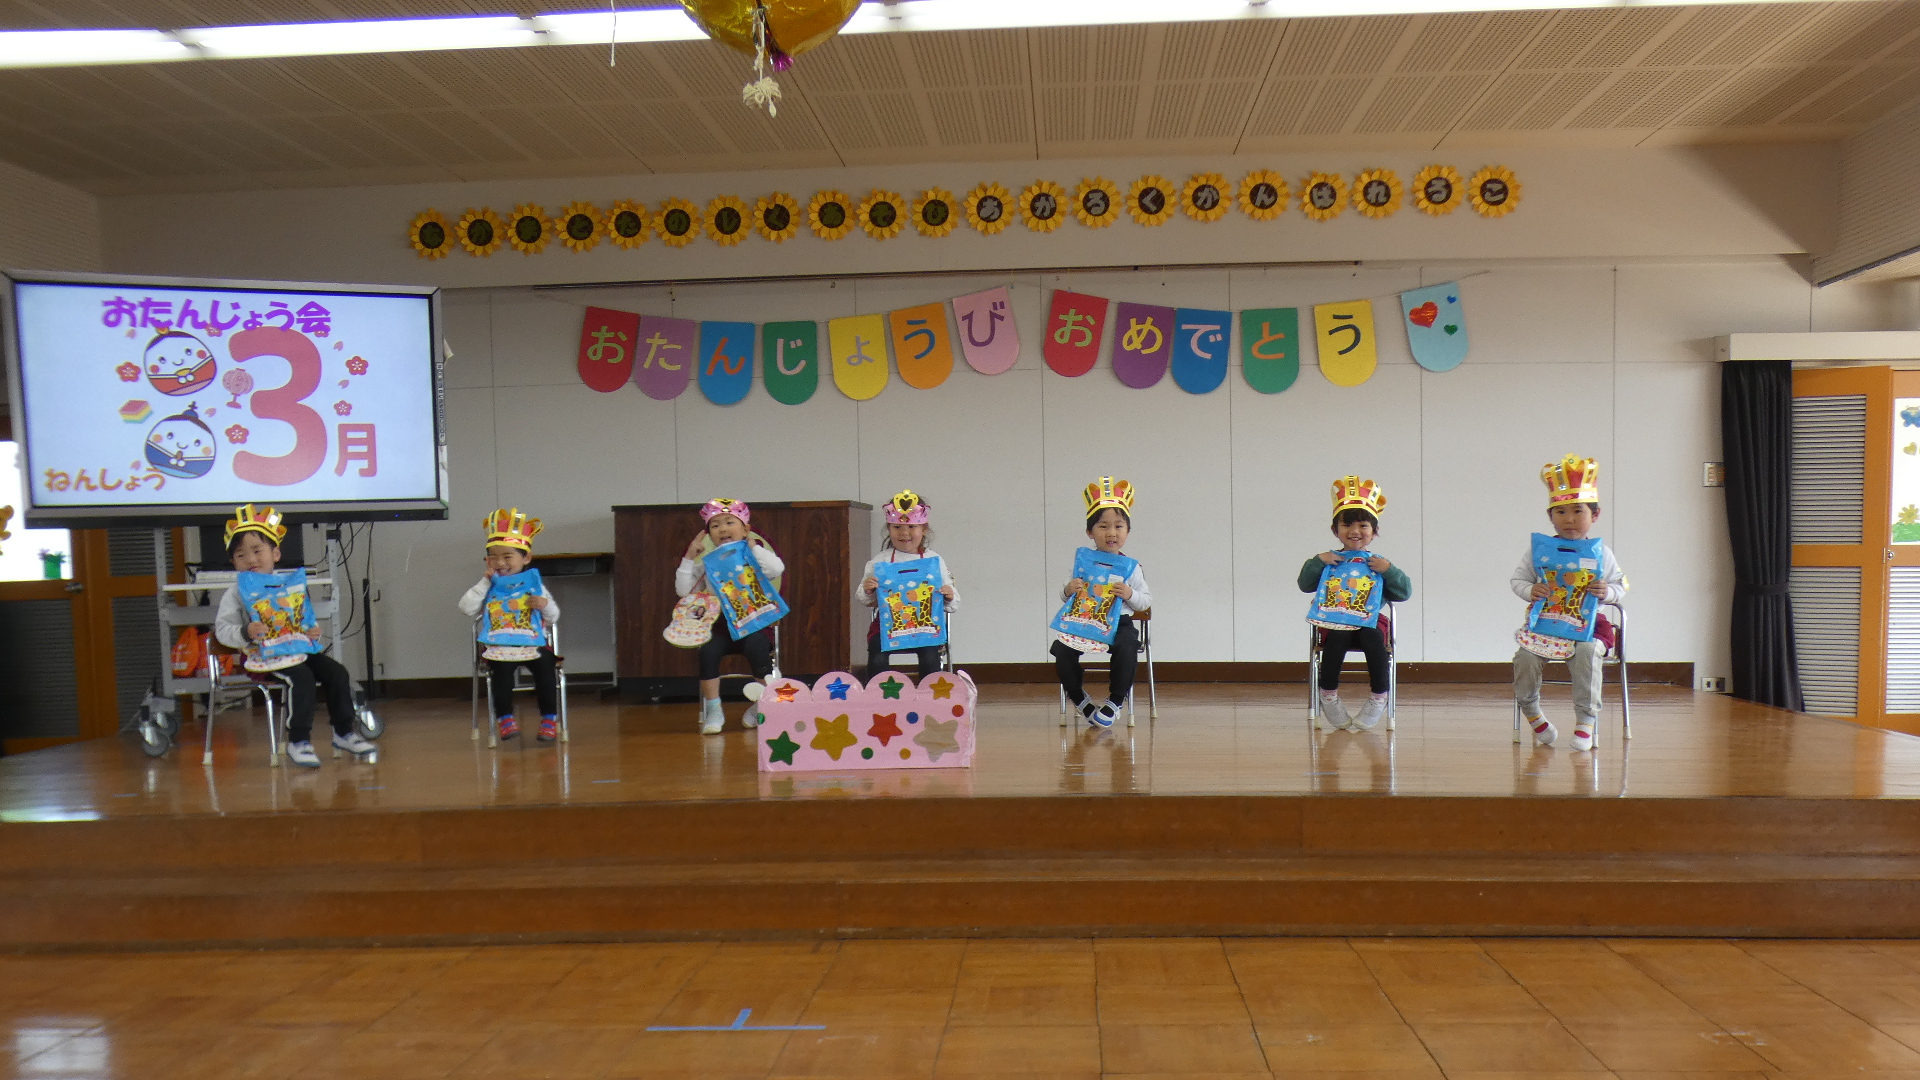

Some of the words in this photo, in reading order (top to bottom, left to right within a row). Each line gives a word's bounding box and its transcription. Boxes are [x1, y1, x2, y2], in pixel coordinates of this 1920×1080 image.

[102, 296, 331, 334] おたんじょう会
[586, 301, 1006, 376] おたんじょうび
[1053, 308, 1361, 360] おめでとう
[44, 467, 166, 492] ねんしょう
